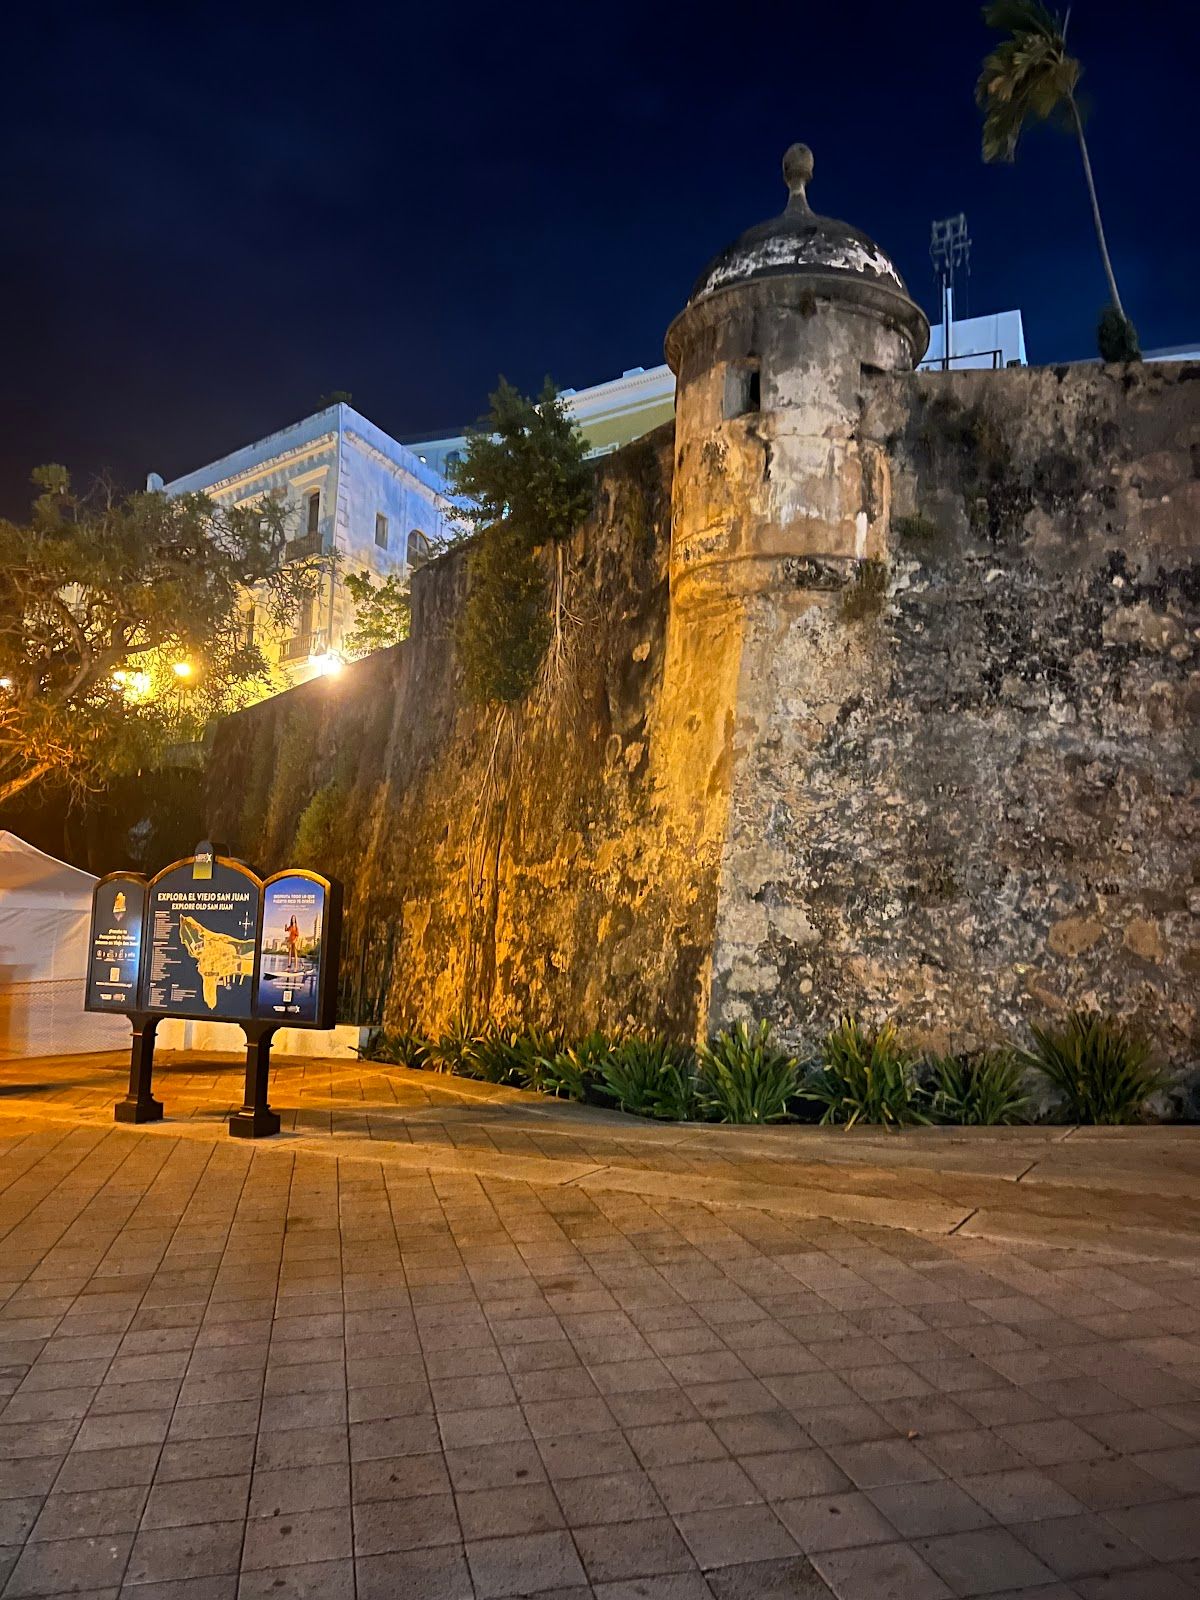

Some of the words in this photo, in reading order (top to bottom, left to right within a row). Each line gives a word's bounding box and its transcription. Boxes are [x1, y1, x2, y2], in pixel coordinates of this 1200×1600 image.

[158, 893, 187, 901] EXPLORA
[197, 893, 216, 901] VIEJO
[217, 893, 231, 901] SAN
